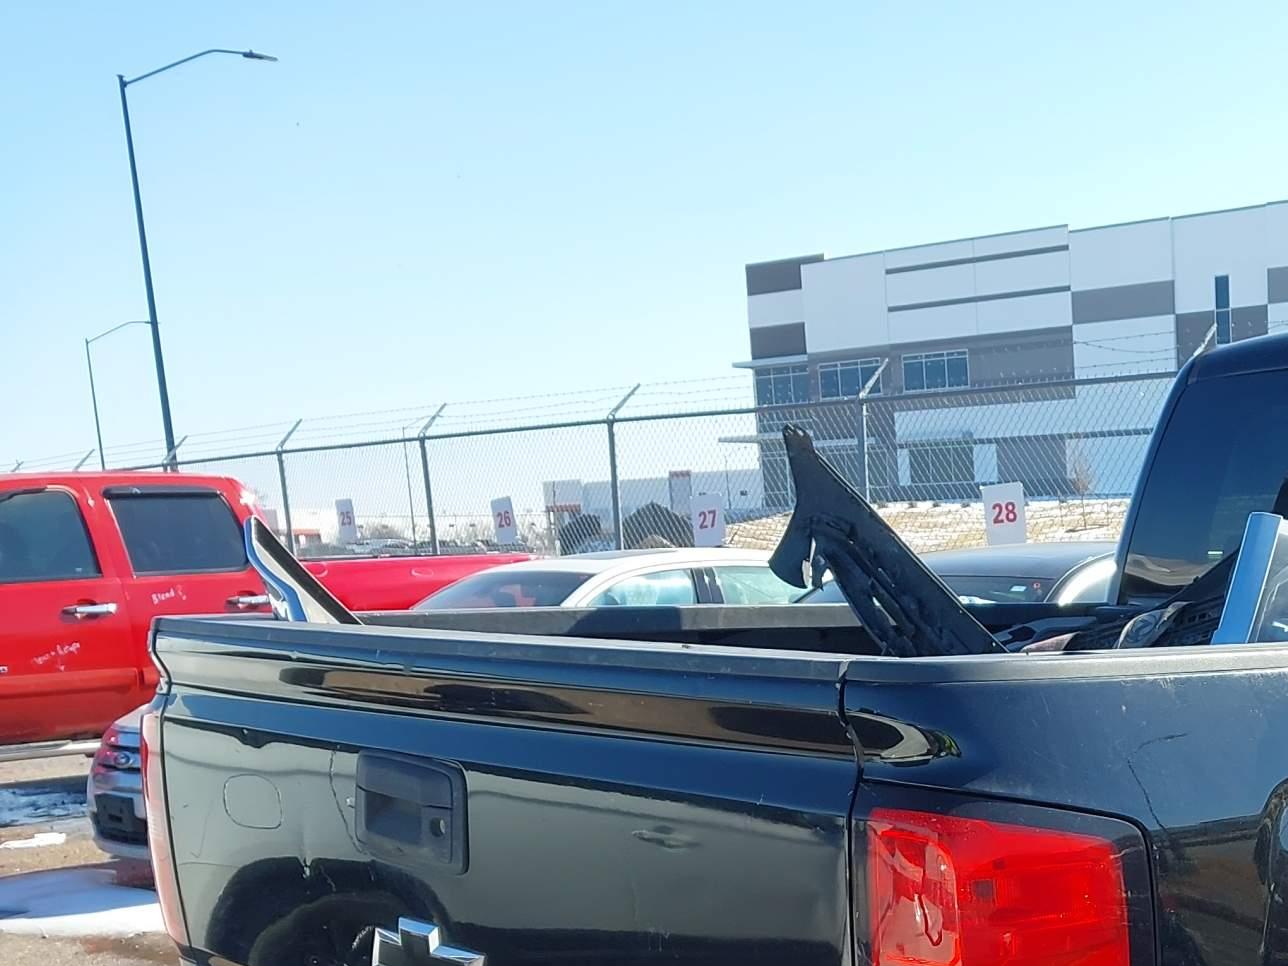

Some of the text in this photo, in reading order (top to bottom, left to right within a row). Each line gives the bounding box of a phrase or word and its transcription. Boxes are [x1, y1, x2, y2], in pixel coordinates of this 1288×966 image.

[341, 511, 353, 526] 25
[496, 510, 511, 528] 26
[698, 509, 718, 531] 27
[992, 502, 1017, 524] 28
